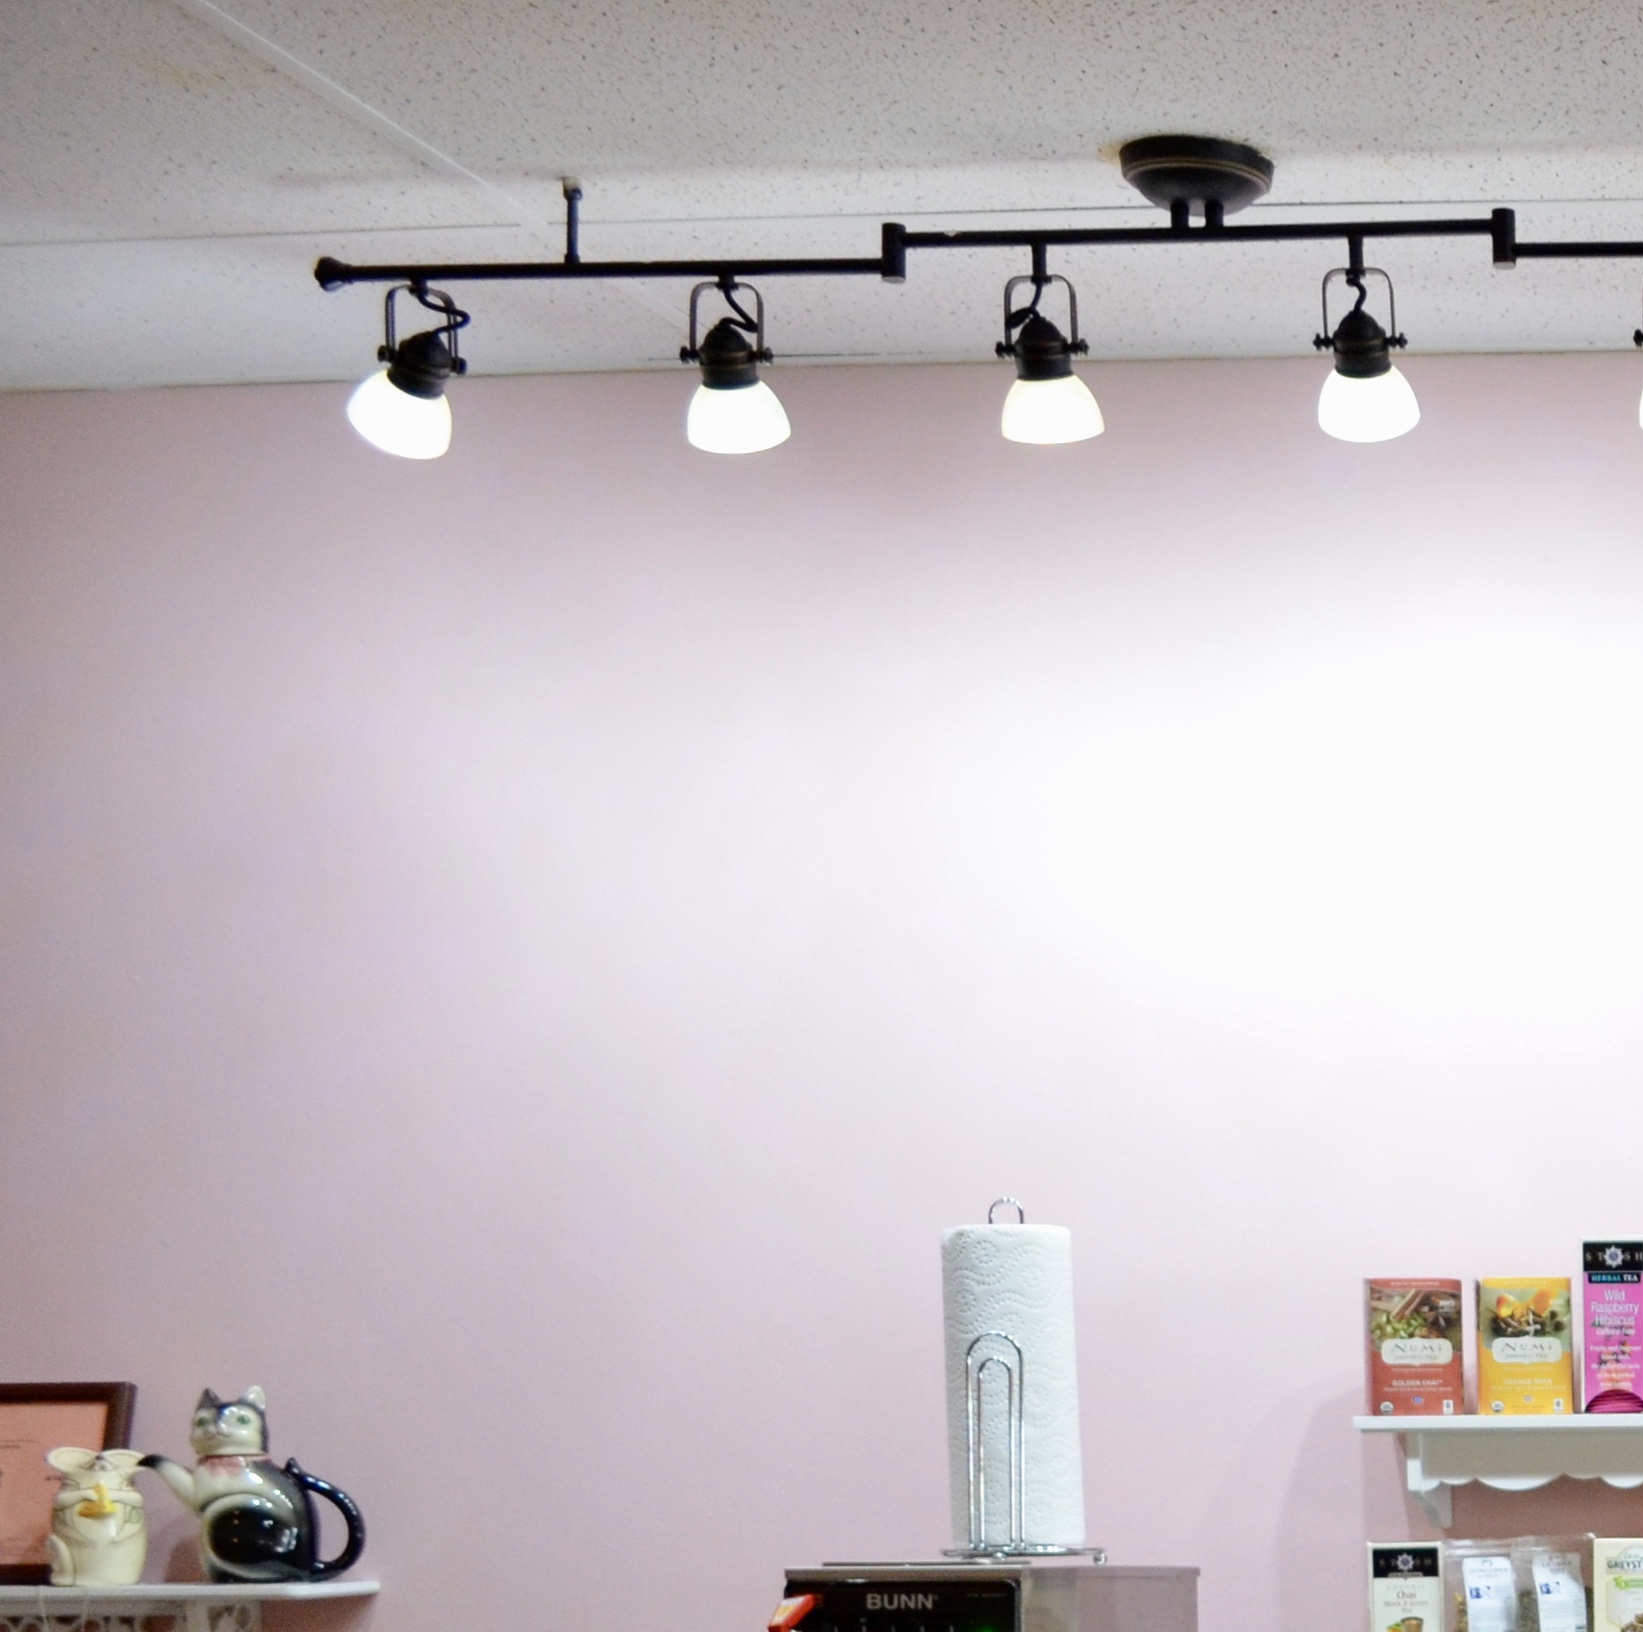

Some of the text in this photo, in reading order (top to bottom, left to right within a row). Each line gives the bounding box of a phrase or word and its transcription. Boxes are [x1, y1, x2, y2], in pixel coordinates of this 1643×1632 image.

[1623, 1274, 1639, 1282] TEA
[1604, 1289, 1626, 1301] Wild
[1590, 1301, 1640, 1315] Raspberry
[1595, 1314, 1636, 1326] Hibiscus
[1396, 1590, 1417, 1600] Chai
[866, 1593, 933, 1610] BUNN
